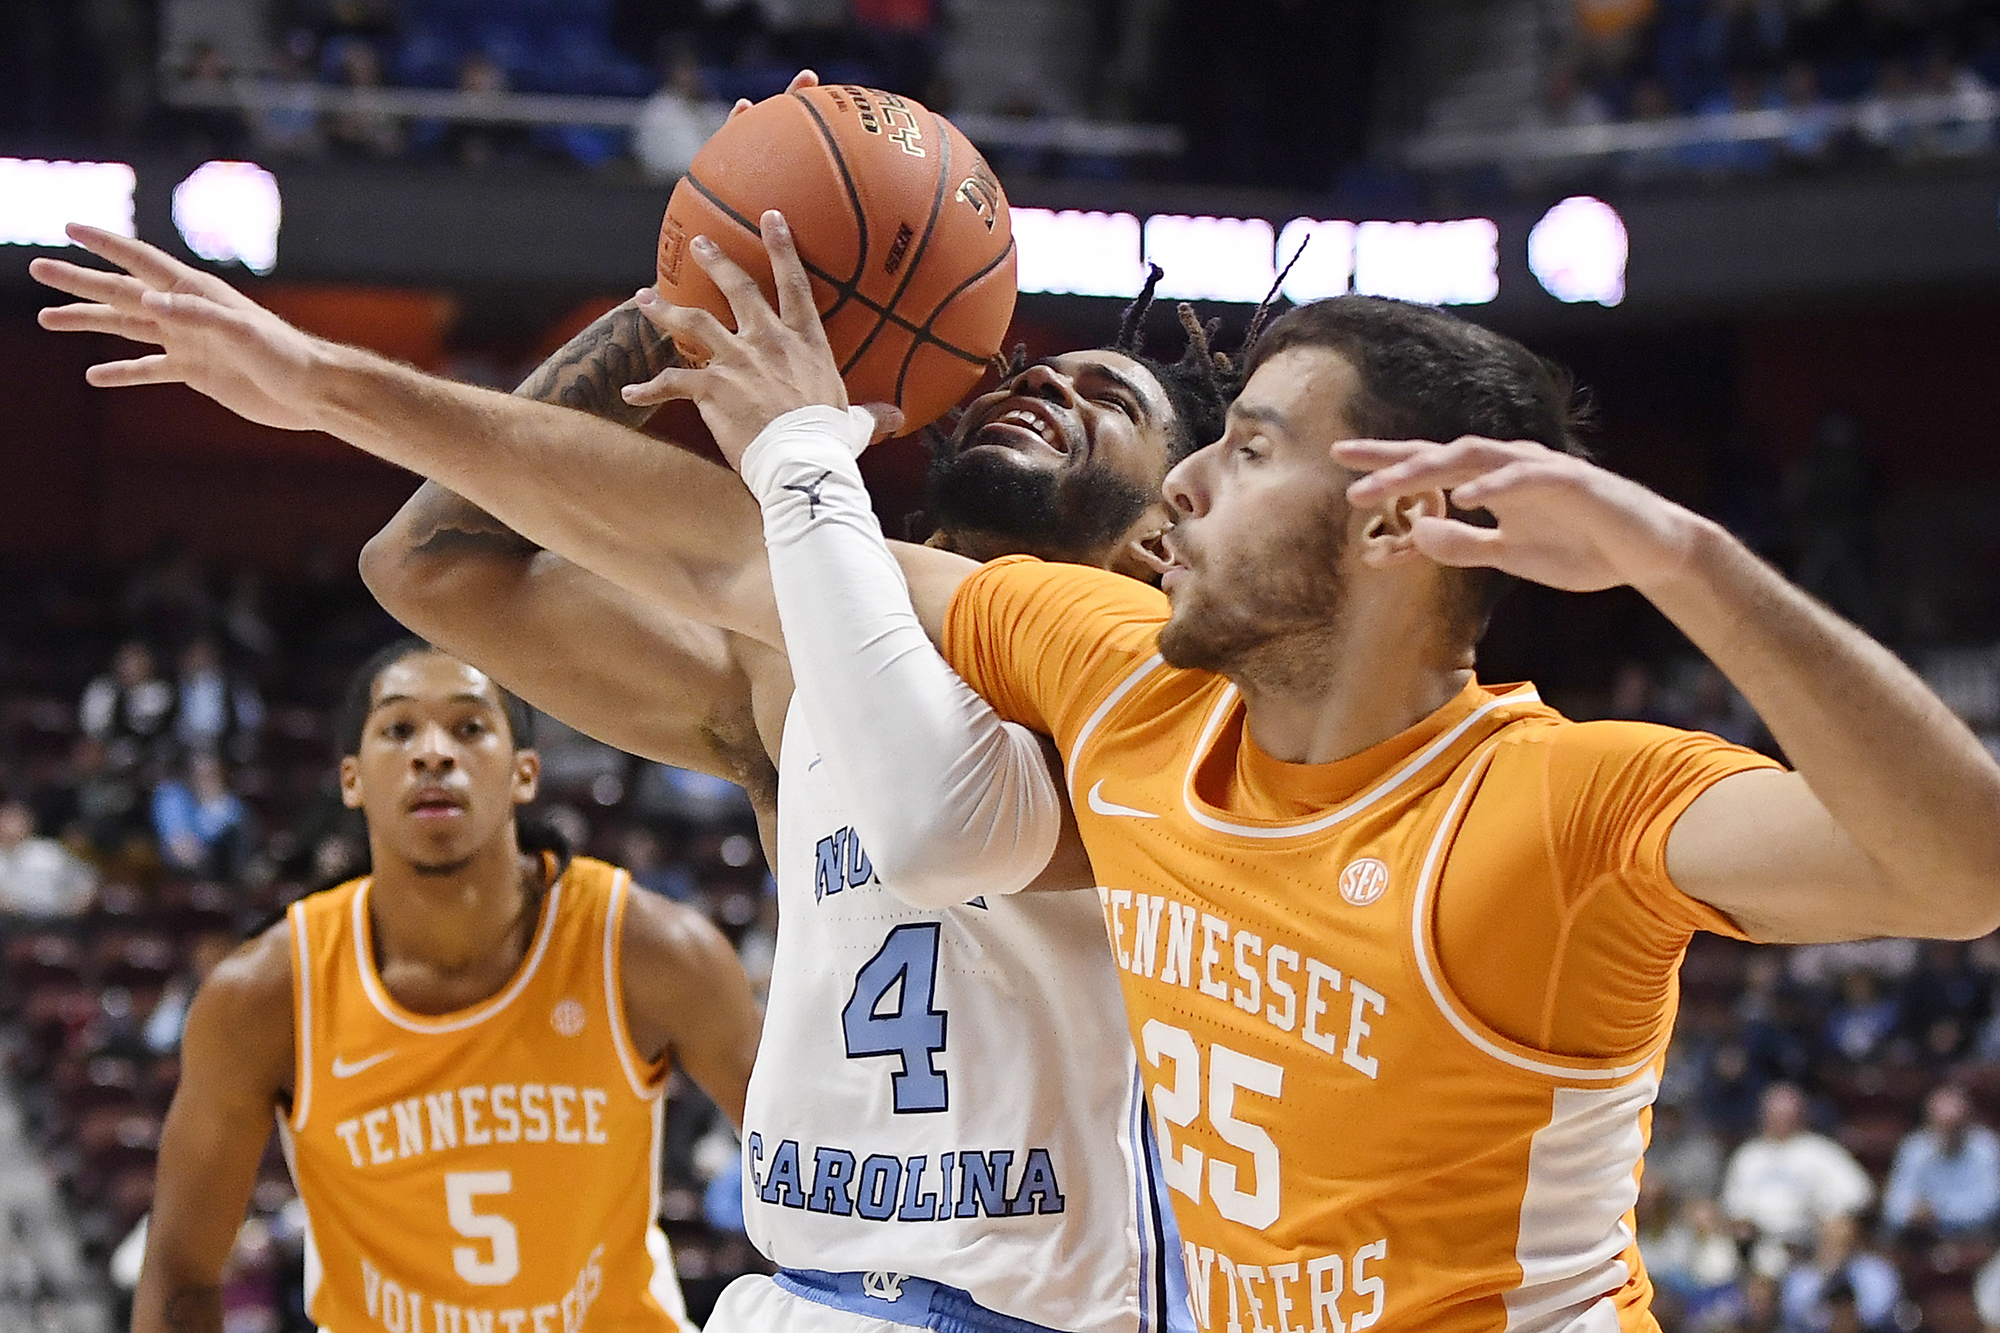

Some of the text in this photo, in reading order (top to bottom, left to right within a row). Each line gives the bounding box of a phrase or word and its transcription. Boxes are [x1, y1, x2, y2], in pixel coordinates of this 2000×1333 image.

[1344, 862, 1385, 900] SEC
[841, 921, 949, 1114] 4
[335, 1083, 608, 1168] TENNESSEE
[748, 1130, 1066, 1222] CAROLINA
[1141, 1018, 1285, 1231] 25
[444, 1170, 520, 1286] 5
